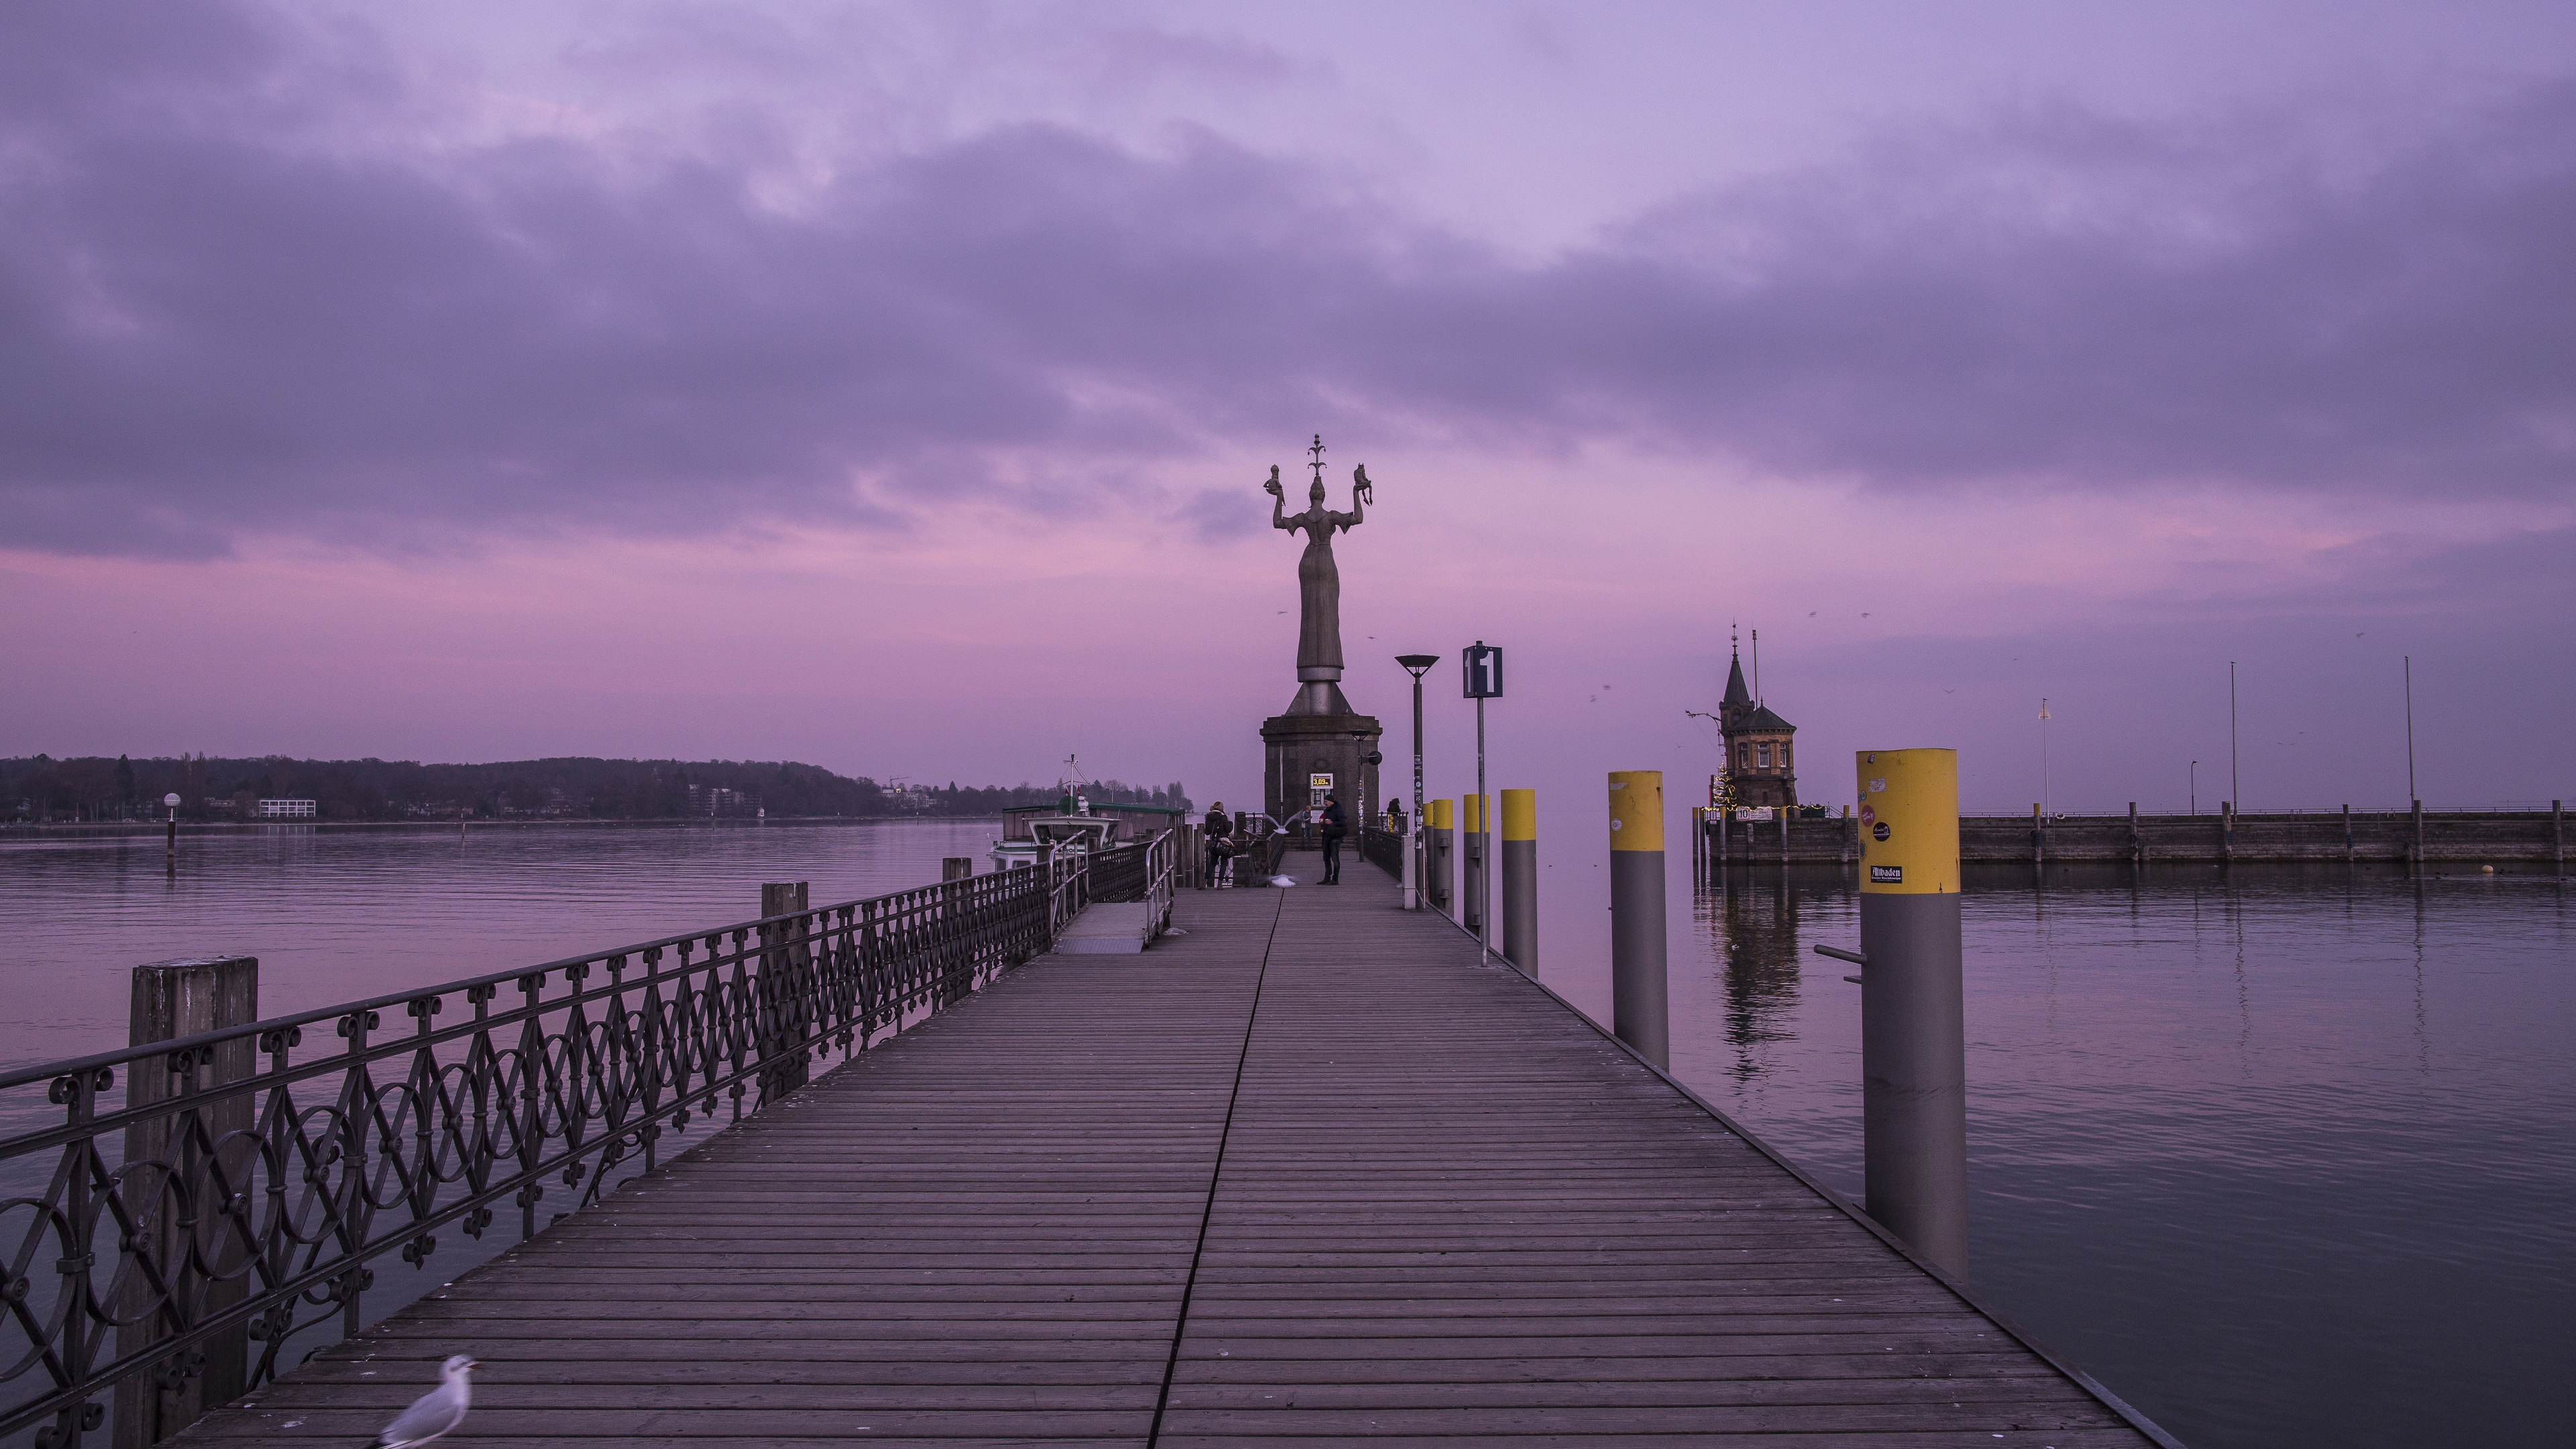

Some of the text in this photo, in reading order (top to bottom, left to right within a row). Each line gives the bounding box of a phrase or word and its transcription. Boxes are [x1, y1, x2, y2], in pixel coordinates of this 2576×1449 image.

[1465, 651, 1470, 692] 1
[1480, 651, 1494, 692] 1
[1739, 810, 1748, 818] 10
[1872, 867, 1900, 876] Altbaden
